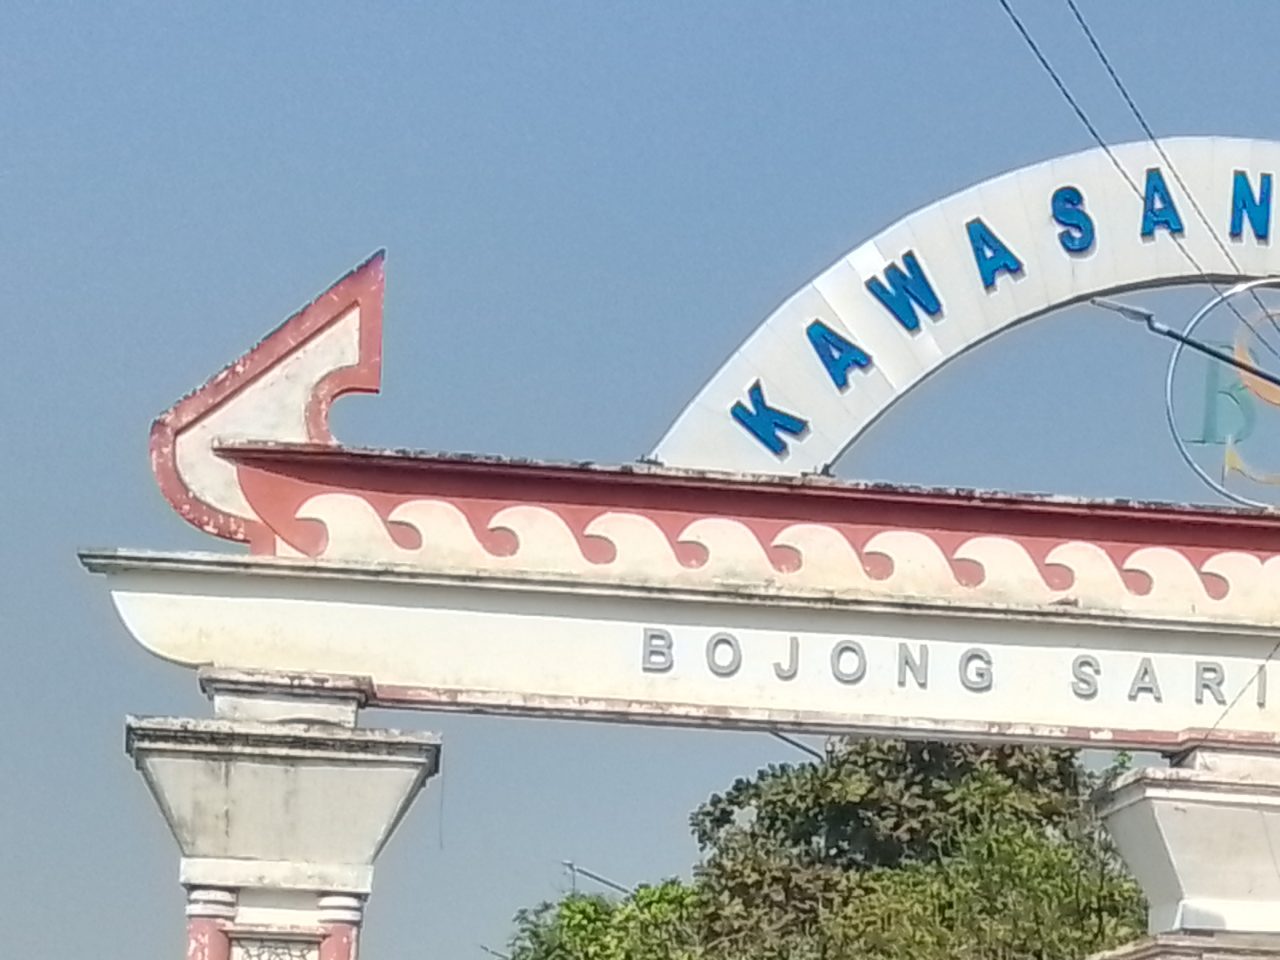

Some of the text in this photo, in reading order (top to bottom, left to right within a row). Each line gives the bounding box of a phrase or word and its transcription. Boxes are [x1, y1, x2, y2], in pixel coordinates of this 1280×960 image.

[730, 166, 1272, 457] KAWASAN
[641, 627, 995, 692] BOJONG
[1070, 654, 1268, 709] SARI
